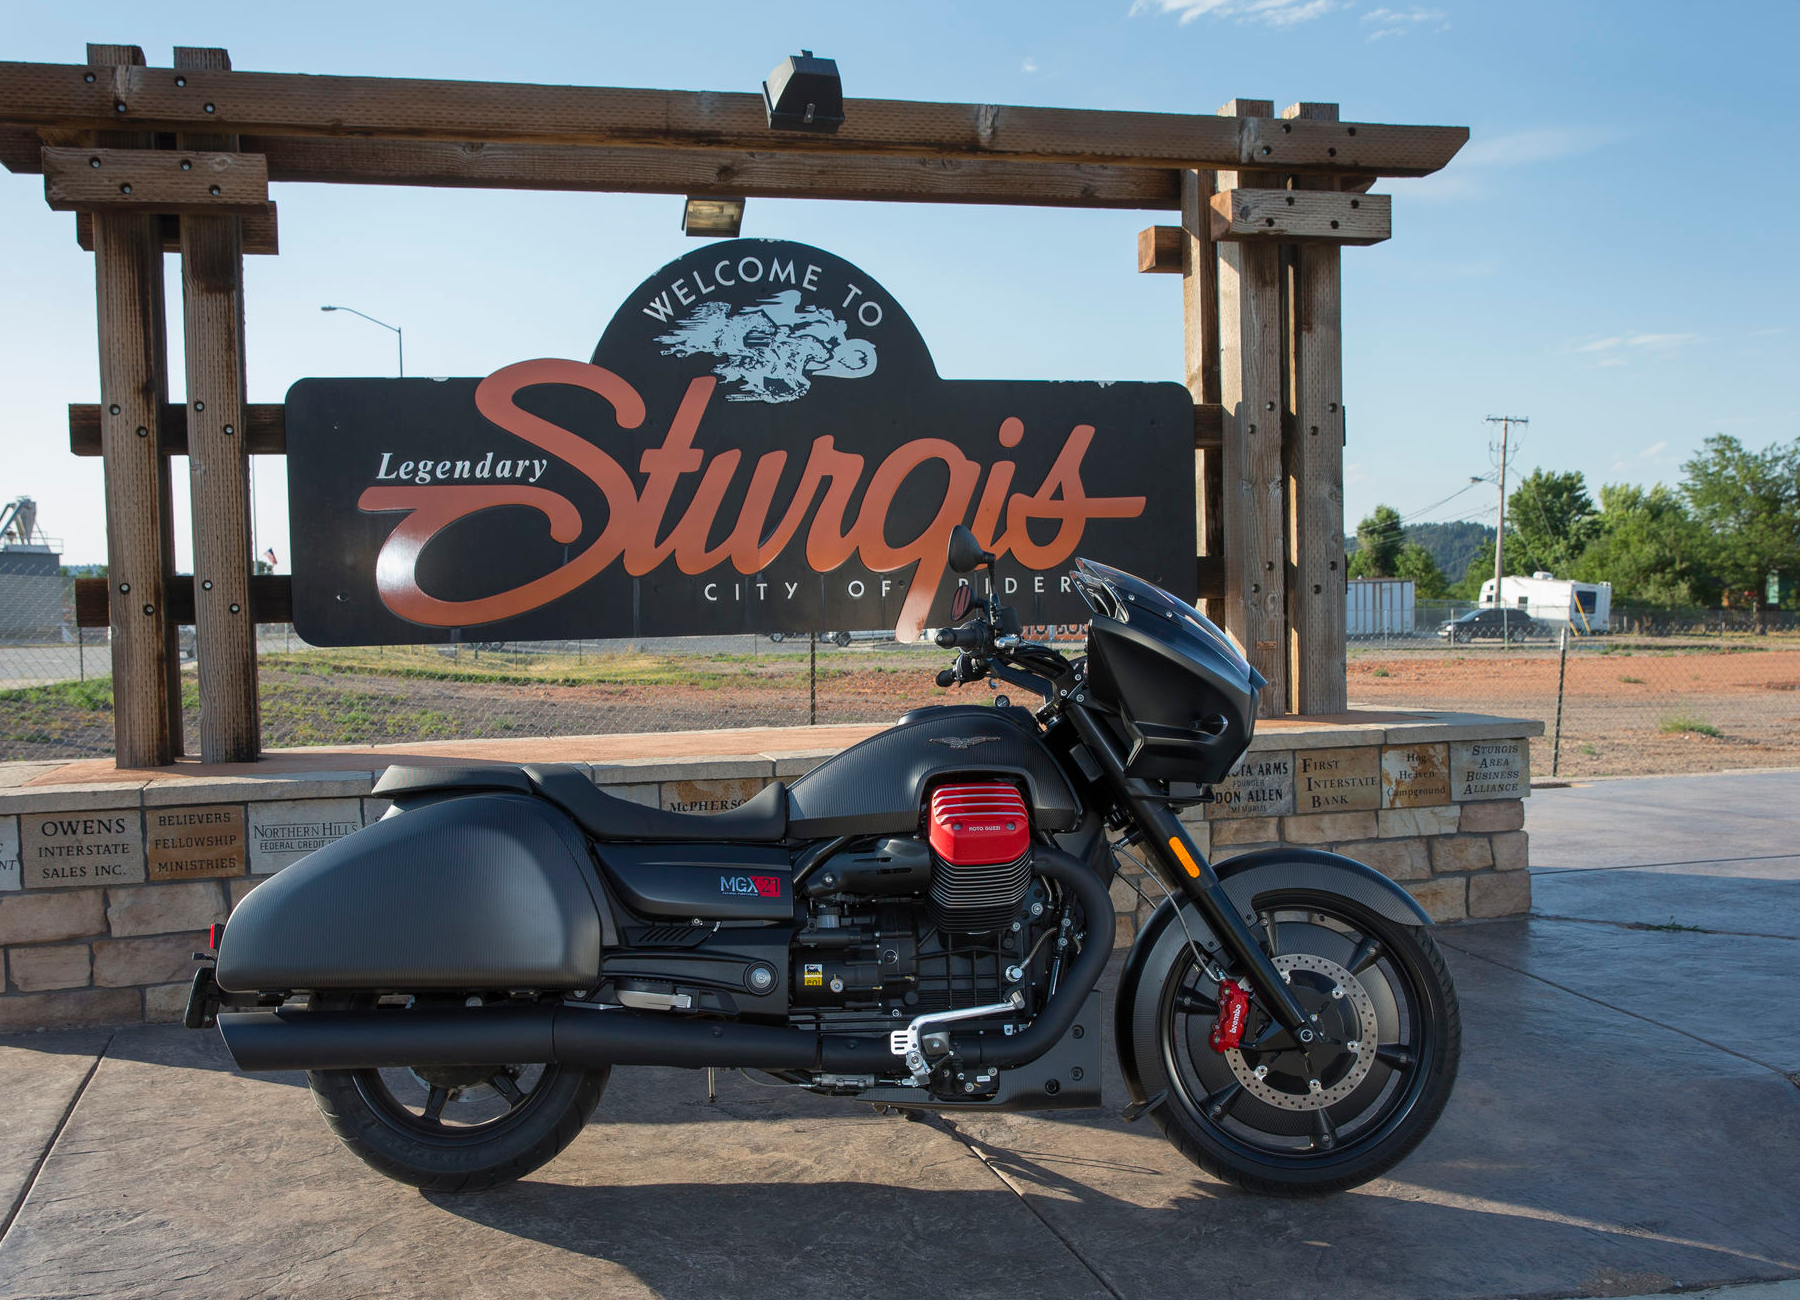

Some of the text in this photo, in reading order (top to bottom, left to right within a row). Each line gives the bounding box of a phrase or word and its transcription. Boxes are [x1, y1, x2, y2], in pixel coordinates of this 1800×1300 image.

[642, 256, 883, 327] WELCOME TO
[376, 452, 548, 484] Legendary
[357, 357, 1147, 643] Sturgis
[704, 581, 798, 601] CITY
[847, 580, 891, 597] OF
[1471, 745, 1519, 756] STURGIS
[1302, 757, 1340, 773] FIRST
[1406, 753, 1427, 764] Hog
[1479, 757, 1510, 769] AREA
[1258, 762, 1288, 776] ARMS
[1399, 770, 1435, 780] Heaven
[1465, 770, 1519, 782] BUSINESS
[1306, 776, 1378, 792] INTERSTATE
[1463, 783, 1519, 795] ALLIANCE
[1215, 789, 1283, 804] DON ALLEN
[1386, 785, 1446, 799] Campground
[669, 799, 752, 812] McPHERSO
[1311, 794, 1349, 809] BANK
[158, 812, 231, 827] BELIEVERS
[41, 818, 126, 837] OWENS
[253, 824, 320, 839] NORTHERN
[155, 834, 237, 849] FELLOWSHIP
[260, 841, 295, 851] FEDERAL
[297, 840, 325, 849] CREDIT
[38, 843, 130, 858] INTERSTATE
[42, 865, 126, 879] SALES INC.
[158, 857, 236, 873] MINISTRIES
[1229, 1004, 1241, 1033] brembo
